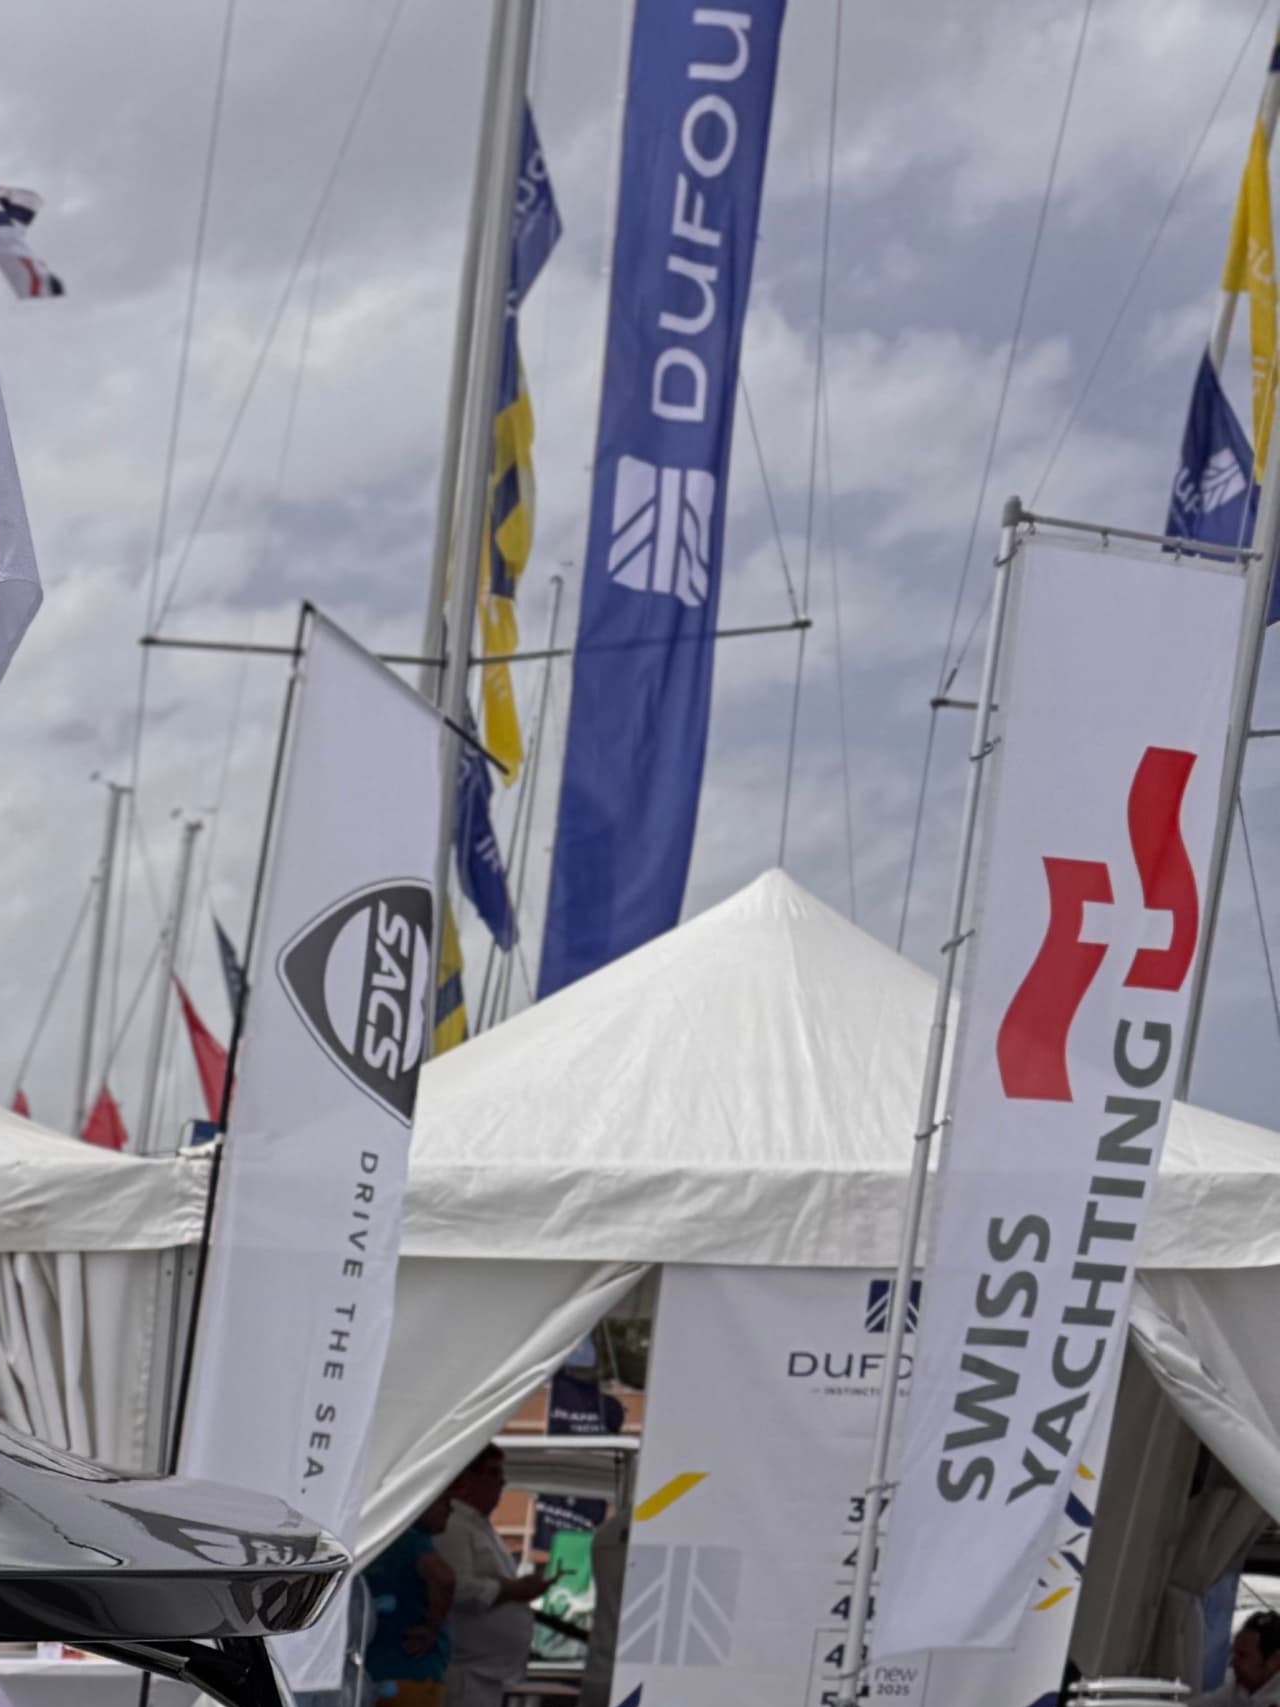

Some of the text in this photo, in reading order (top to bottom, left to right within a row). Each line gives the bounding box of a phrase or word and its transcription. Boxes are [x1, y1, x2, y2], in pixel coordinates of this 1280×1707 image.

[651, 8, 751, 422] DUFOU
[363, 900, 410, 1080] SACS
[300, 1150, 379, 1494] DRIVE THE SEA.
[937, 1214, 1050, 1503] SWISS
[1006, 1018, 1172, 1505] YACHTING
[825, 1644, 868, 1669] 4
[874, 1666, 918, 1682] new
